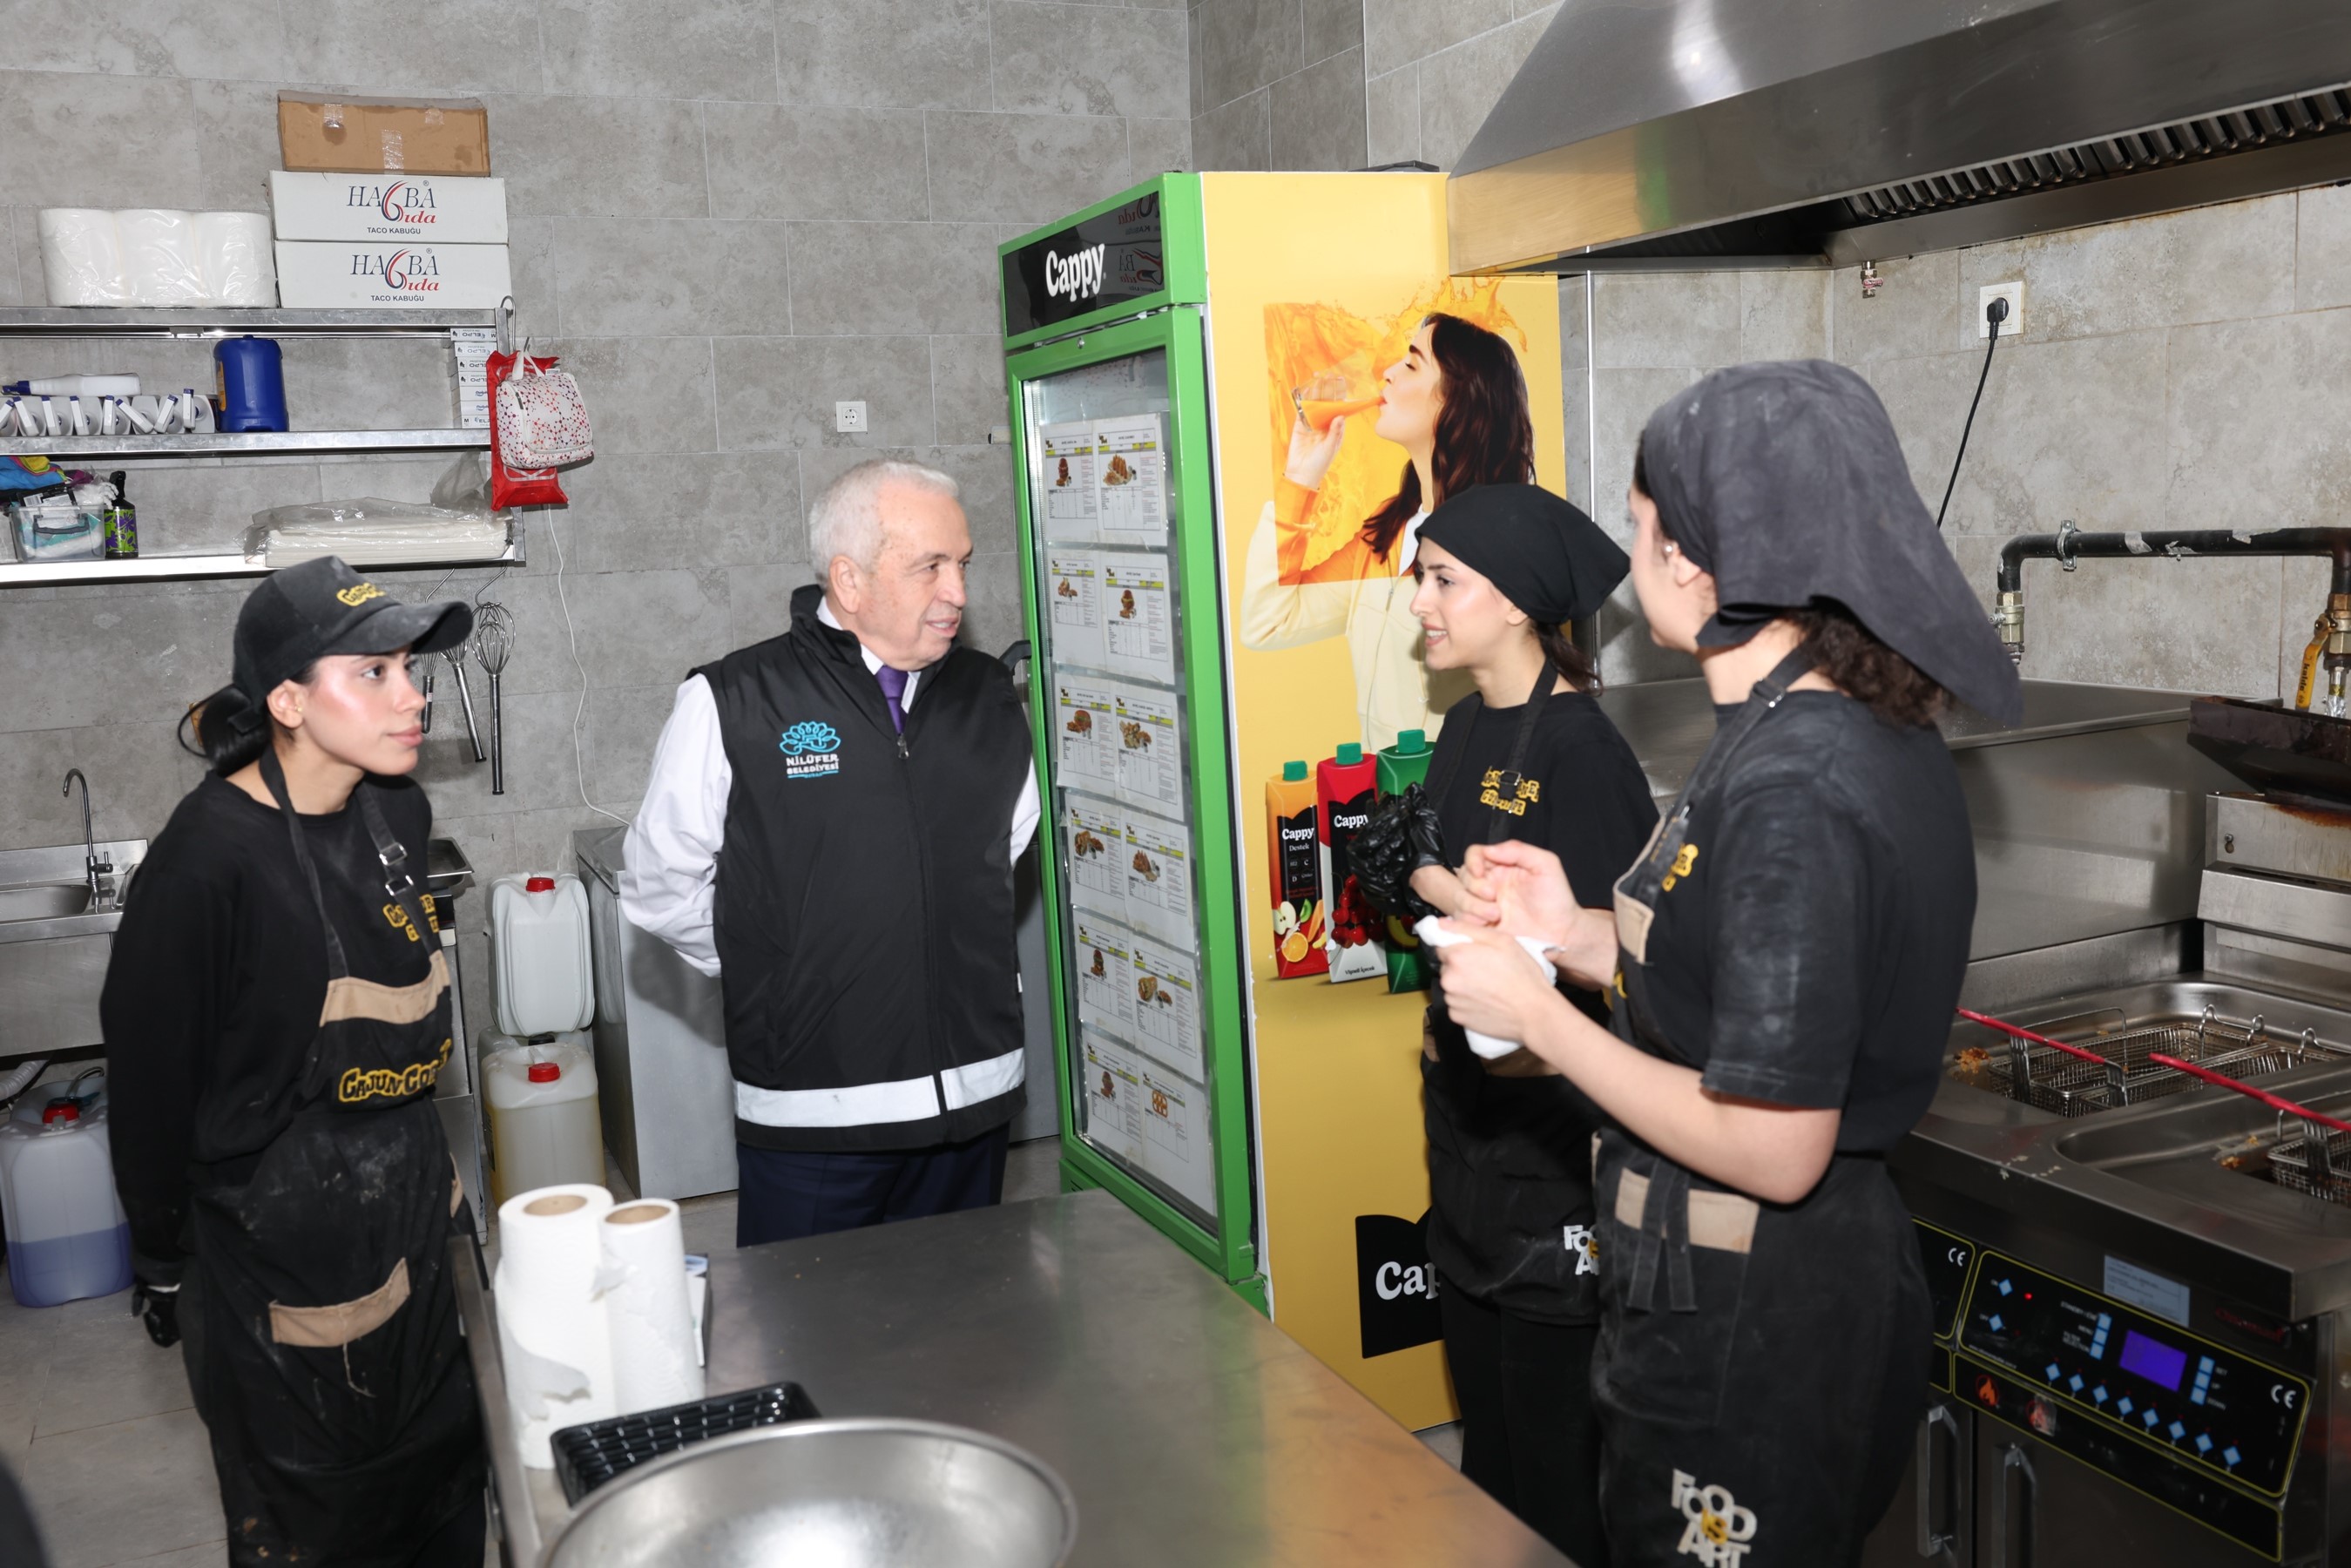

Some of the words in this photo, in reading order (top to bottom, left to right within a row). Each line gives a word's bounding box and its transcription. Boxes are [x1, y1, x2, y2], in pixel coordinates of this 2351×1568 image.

[1045, 243, 1105, 302] Cappy
[786, 754, 840, 766] NİLÜFER
[1282, 828, 1314, 841] Cappy
[1289, 843, 1309, 852] Destek
[339, 1067, 402, 1102] CAJUN
